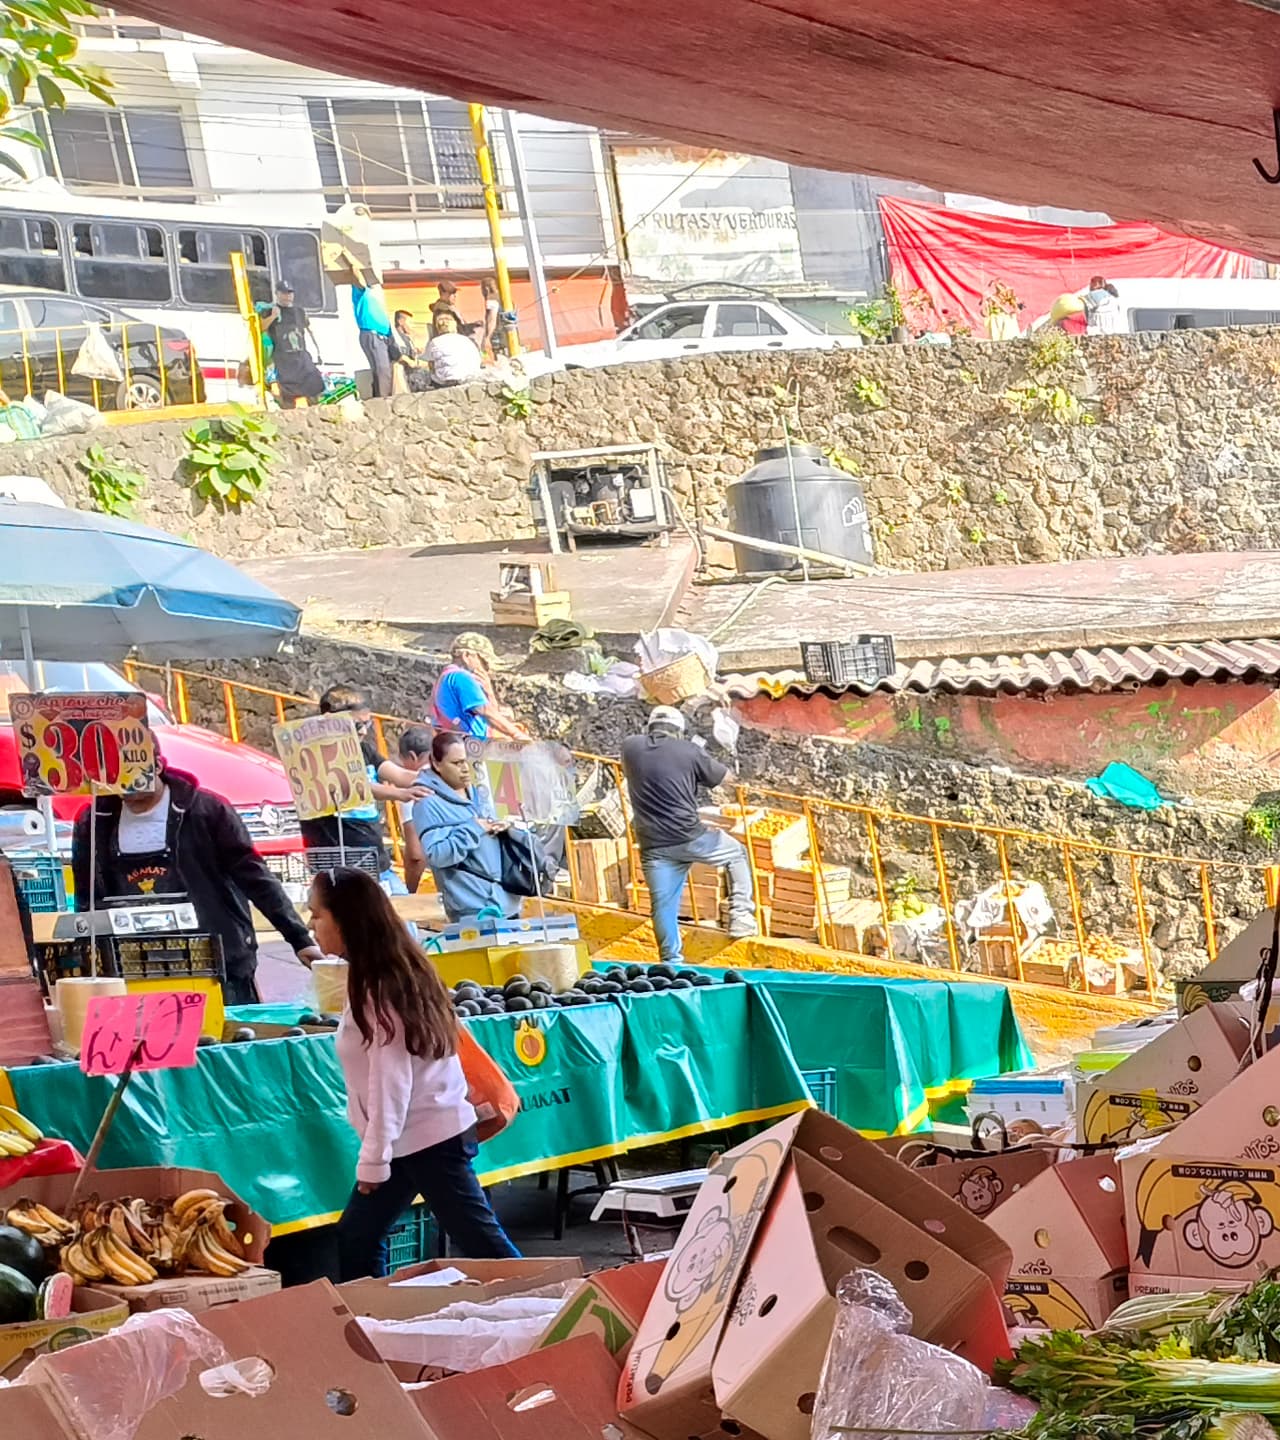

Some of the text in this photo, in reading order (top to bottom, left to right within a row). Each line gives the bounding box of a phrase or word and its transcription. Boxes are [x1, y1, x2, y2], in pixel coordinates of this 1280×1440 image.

[724, 211, 798, 231] VERDURAS
[42, 720, 121, 793] 30
[122, 749, 148, 763] KILO
[299, 740, 352, 812] 35
